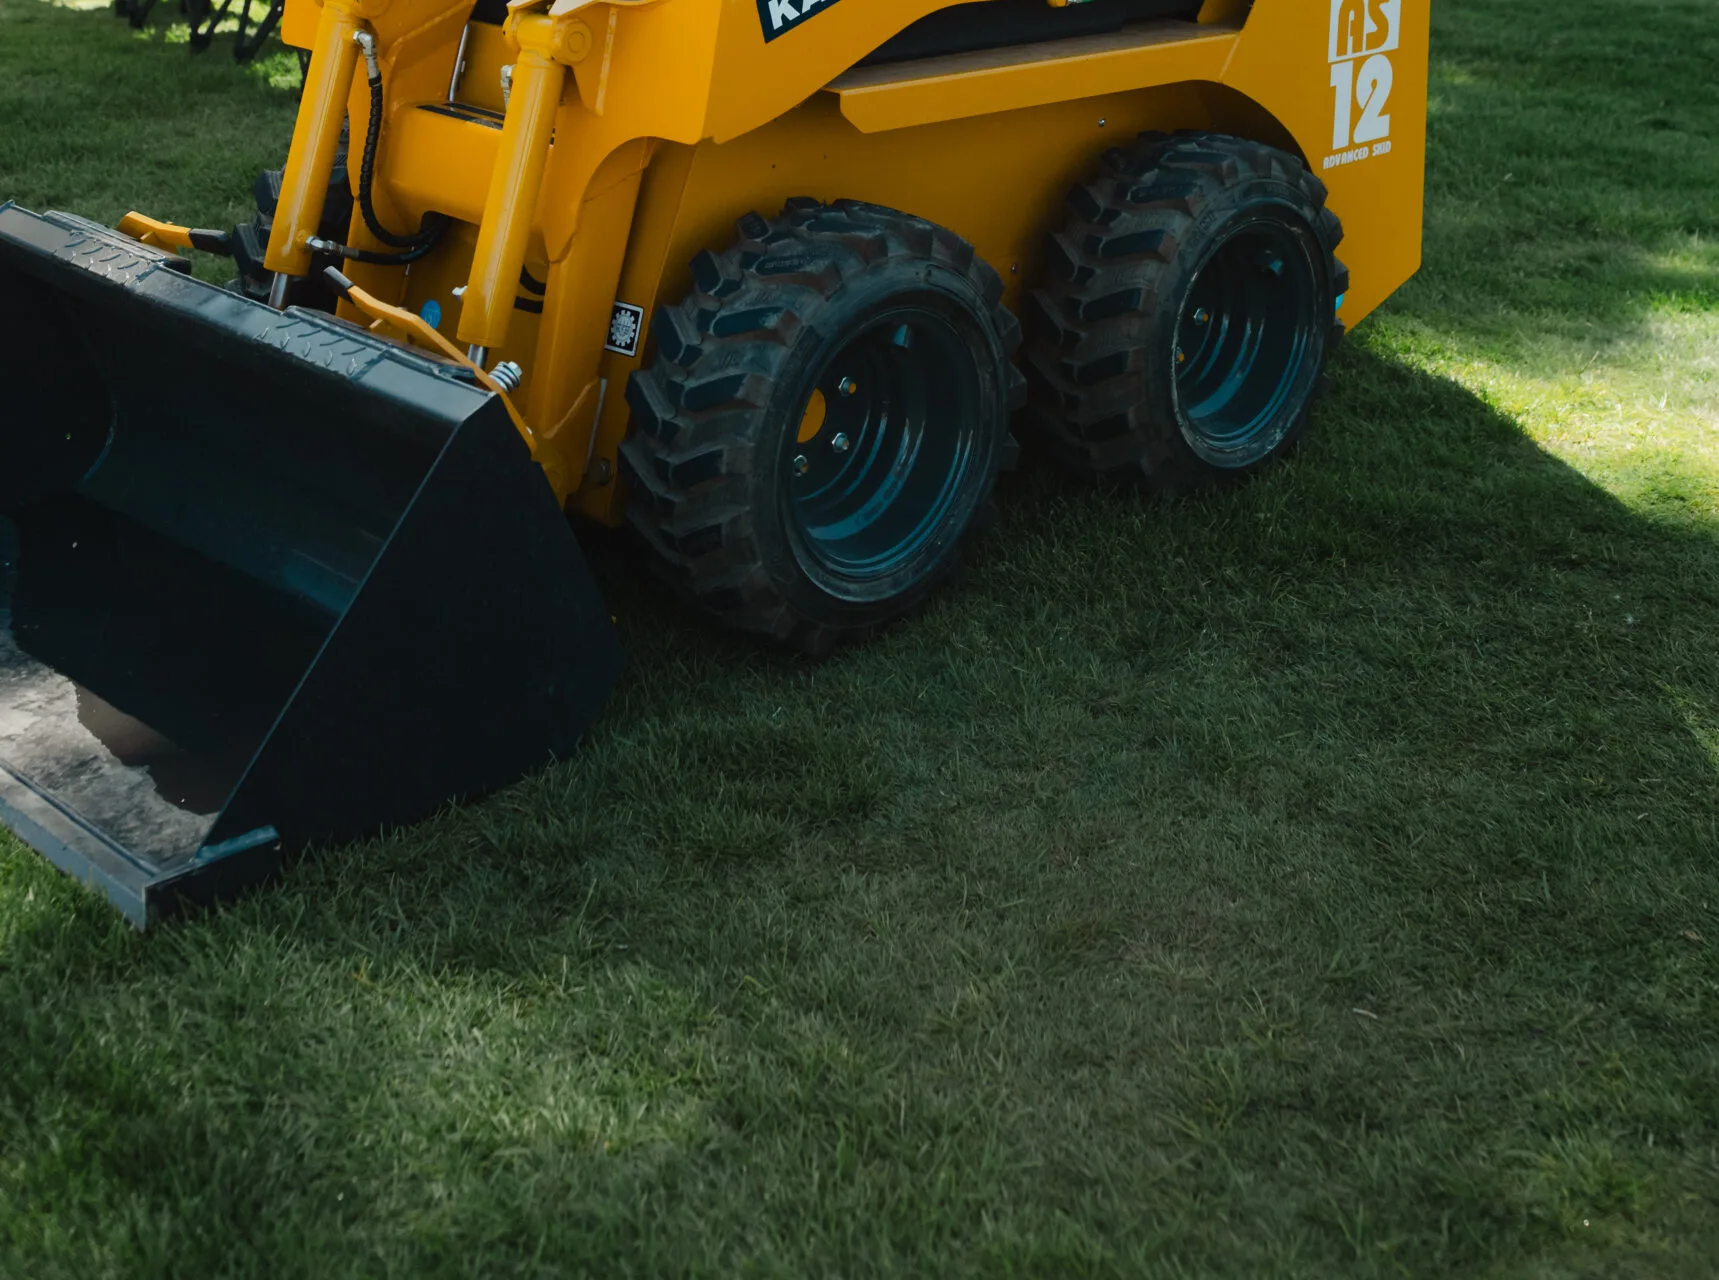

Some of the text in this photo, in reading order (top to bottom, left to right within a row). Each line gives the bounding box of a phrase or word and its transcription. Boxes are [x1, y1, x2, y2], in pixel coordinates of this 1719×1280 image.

[1330, 54, 1393, 150] 12
[1323, 140, 1392, 170] ADVANCED SKID
